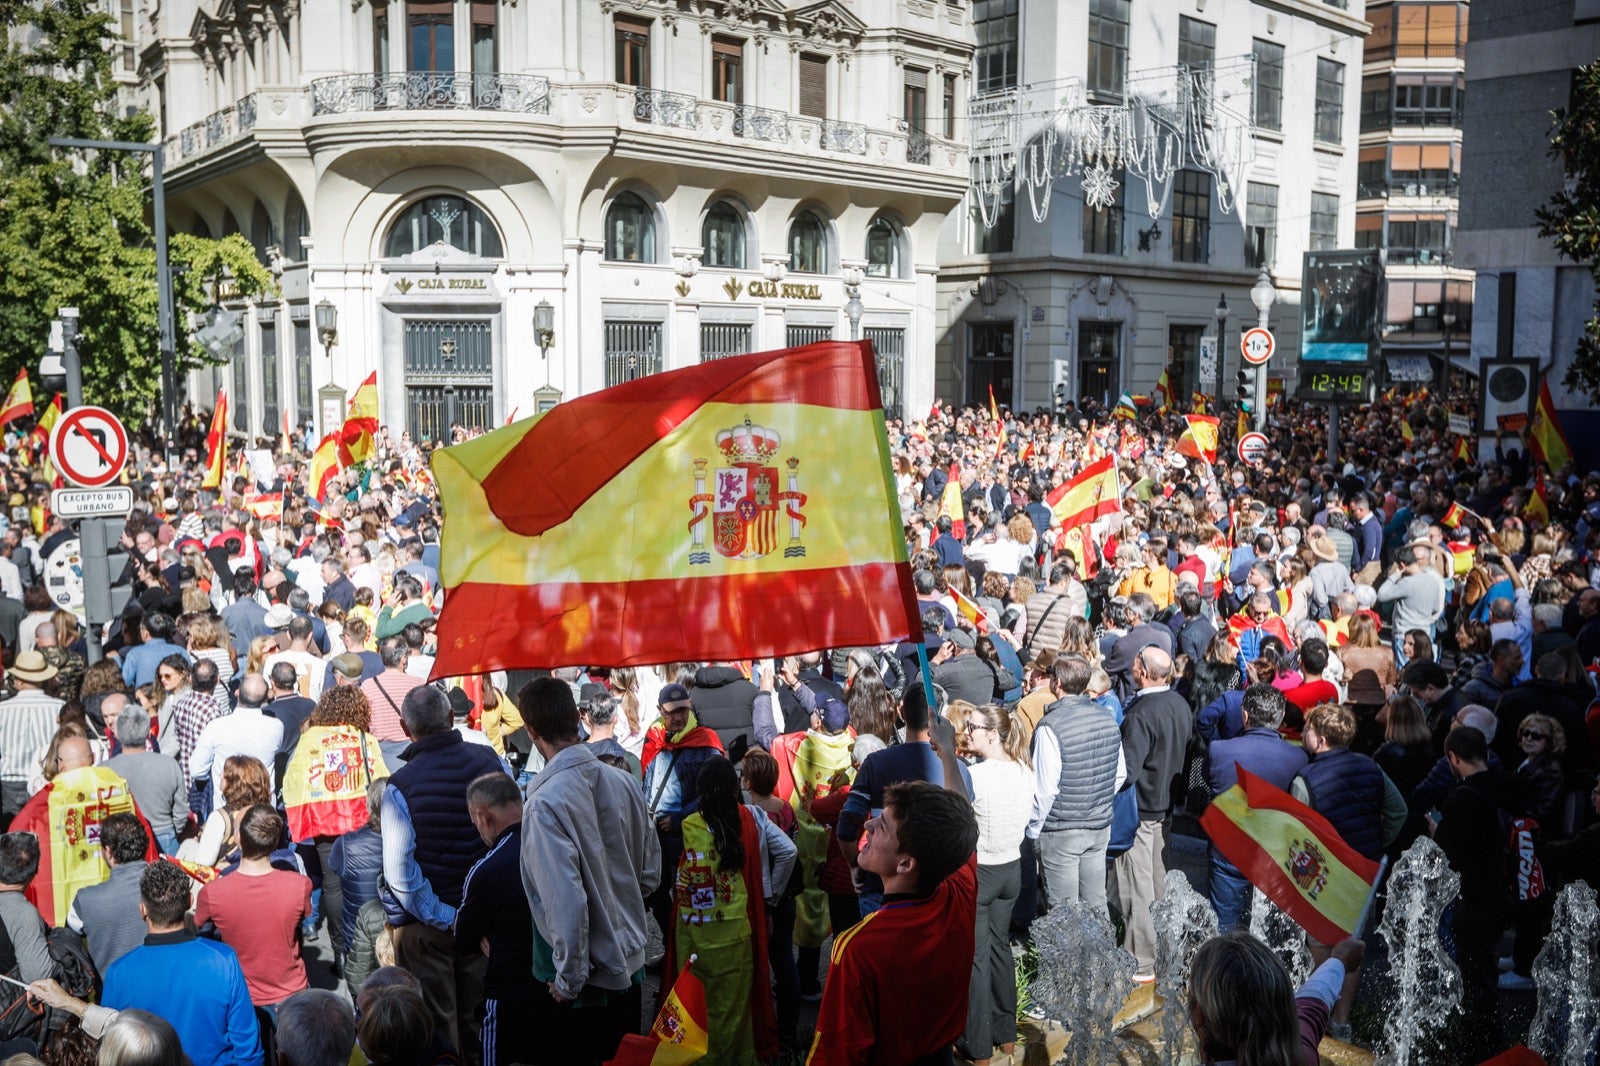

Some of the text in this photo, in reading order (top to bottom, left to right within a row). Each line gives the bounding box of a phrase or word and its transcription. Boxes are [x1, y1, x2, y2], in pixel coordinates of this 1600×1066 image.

[417, 279, 487, 290] CAJA RURAL
[780, 282, 822, 300] RURAL
[1311, 373, 1363, 393] 12:49
[63, 493, 103, 502] EXCEPTO
[77, 503, 114, 511] URBANO
